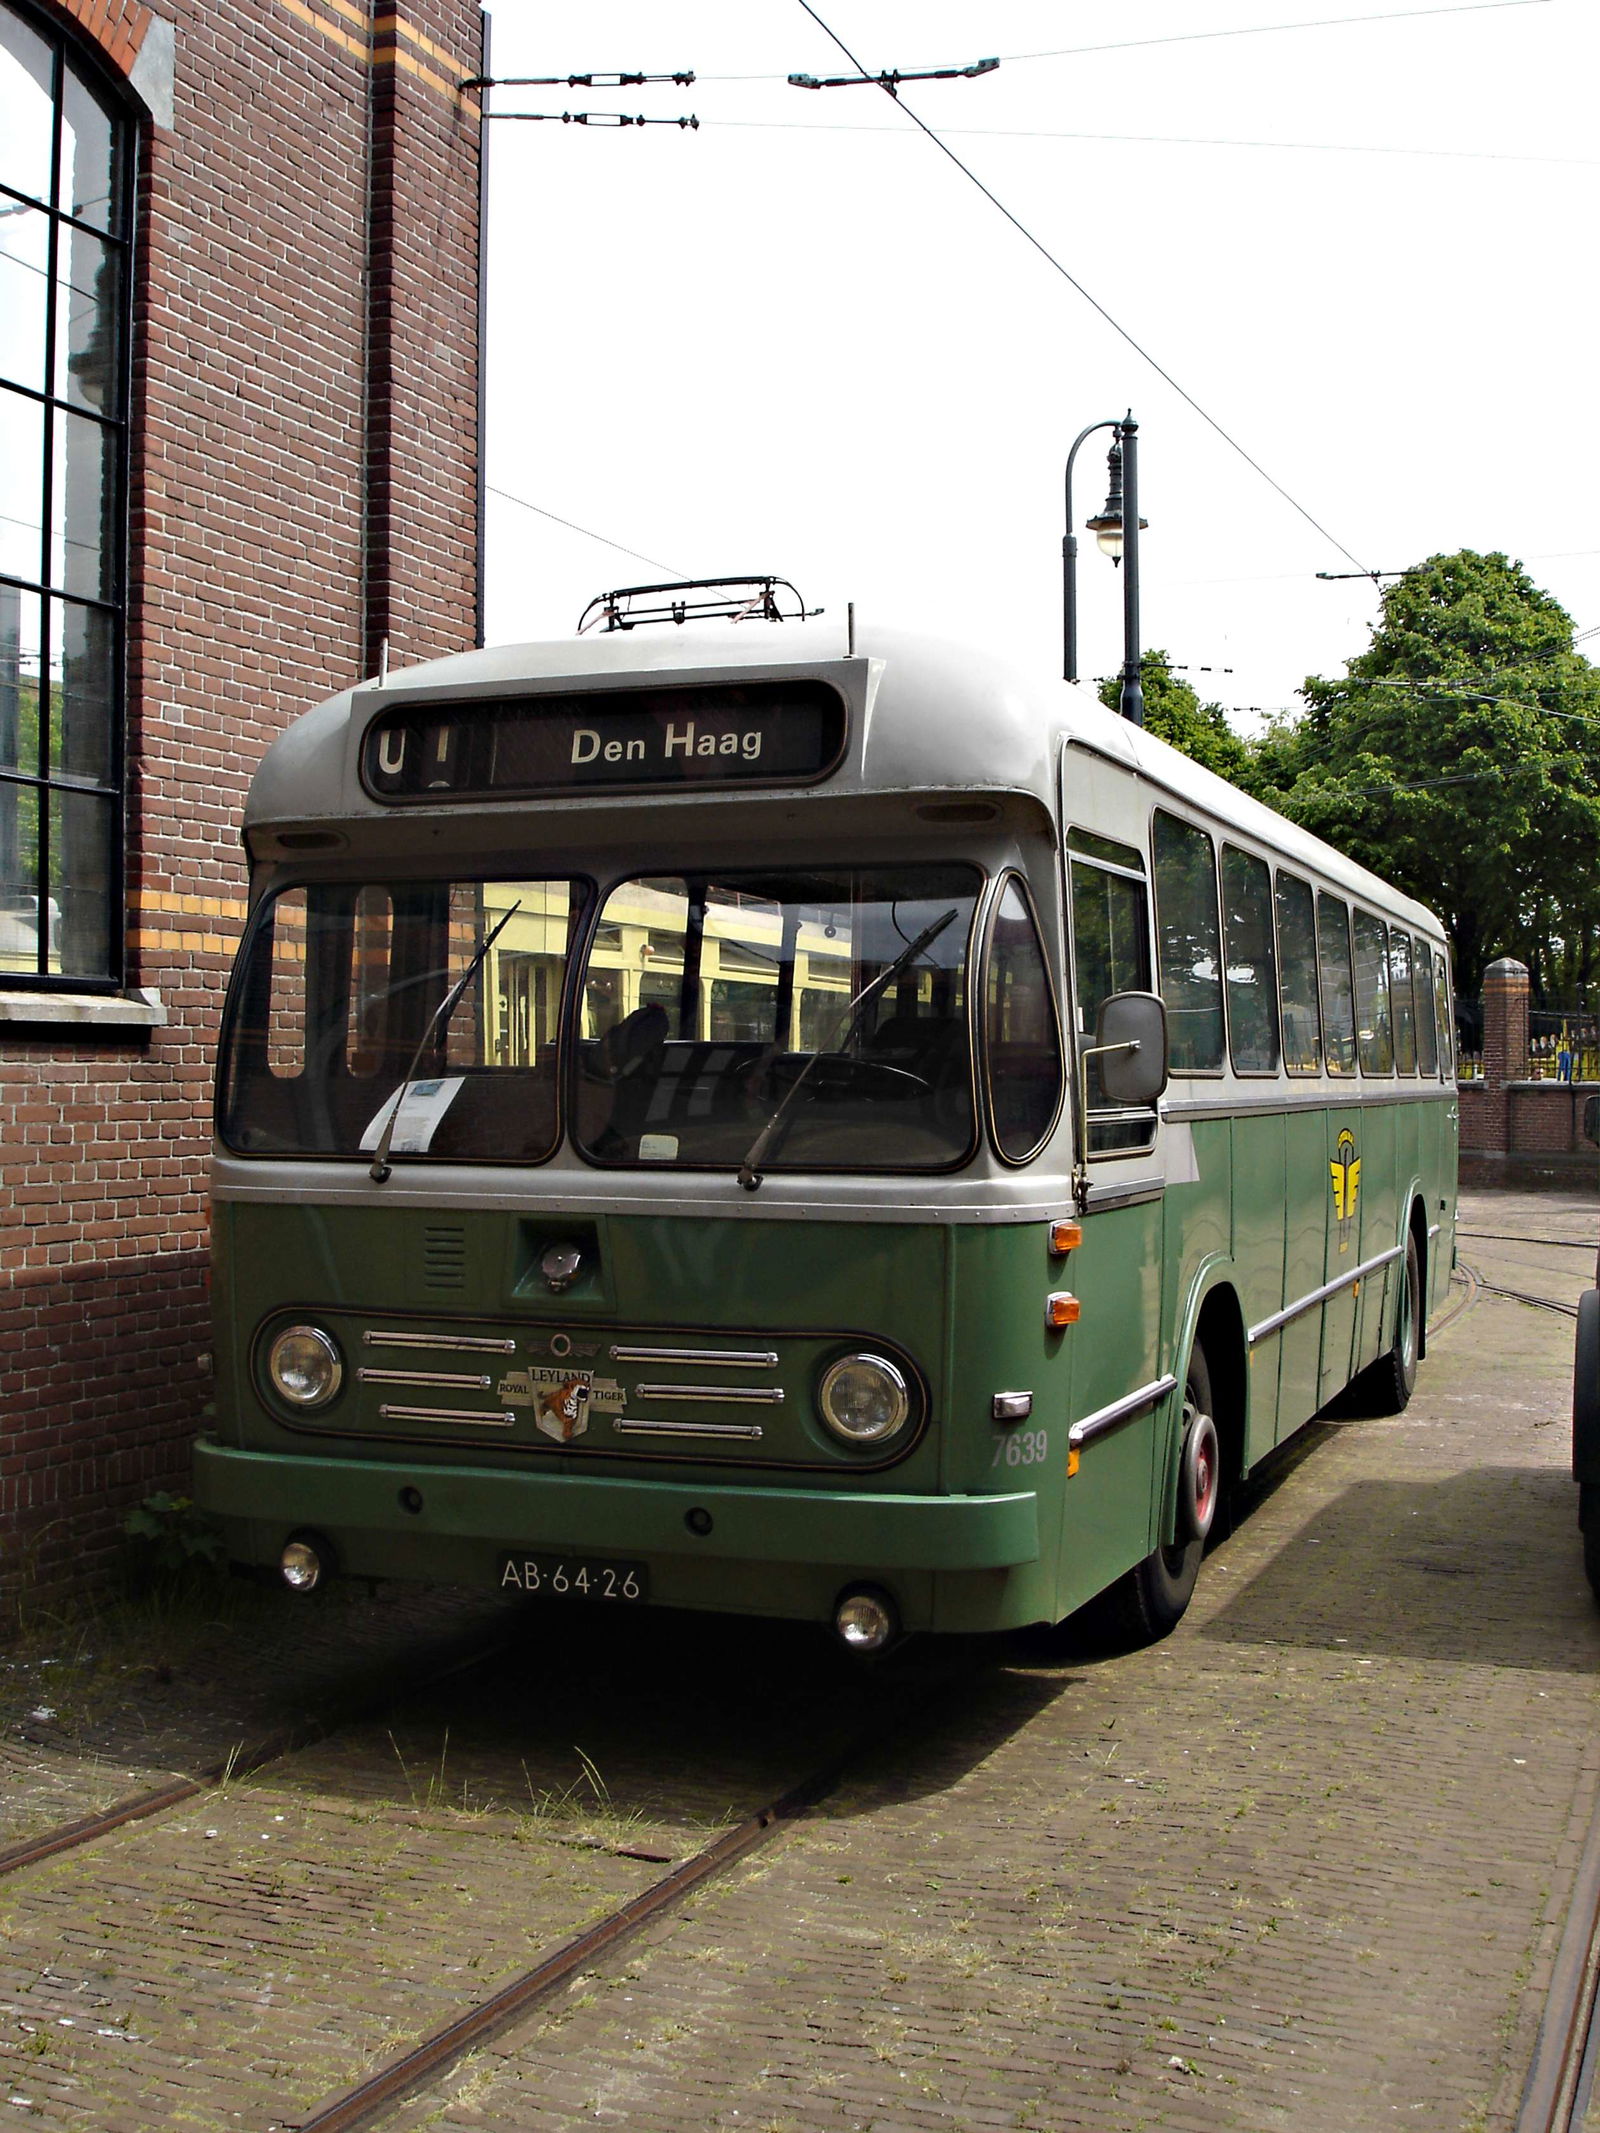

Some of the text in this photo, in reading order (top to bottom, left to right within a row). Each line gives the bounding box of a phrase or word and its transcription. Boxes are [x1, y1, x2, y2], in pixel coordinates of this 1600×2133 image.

[571, 721, 762, 764] Den Haag
[531, 1368, 591, 1384] LEYLAND
[499, 1382, 624, 1401] ROYAL TIGER
[991, 1429, 1048, 1467] 7639
